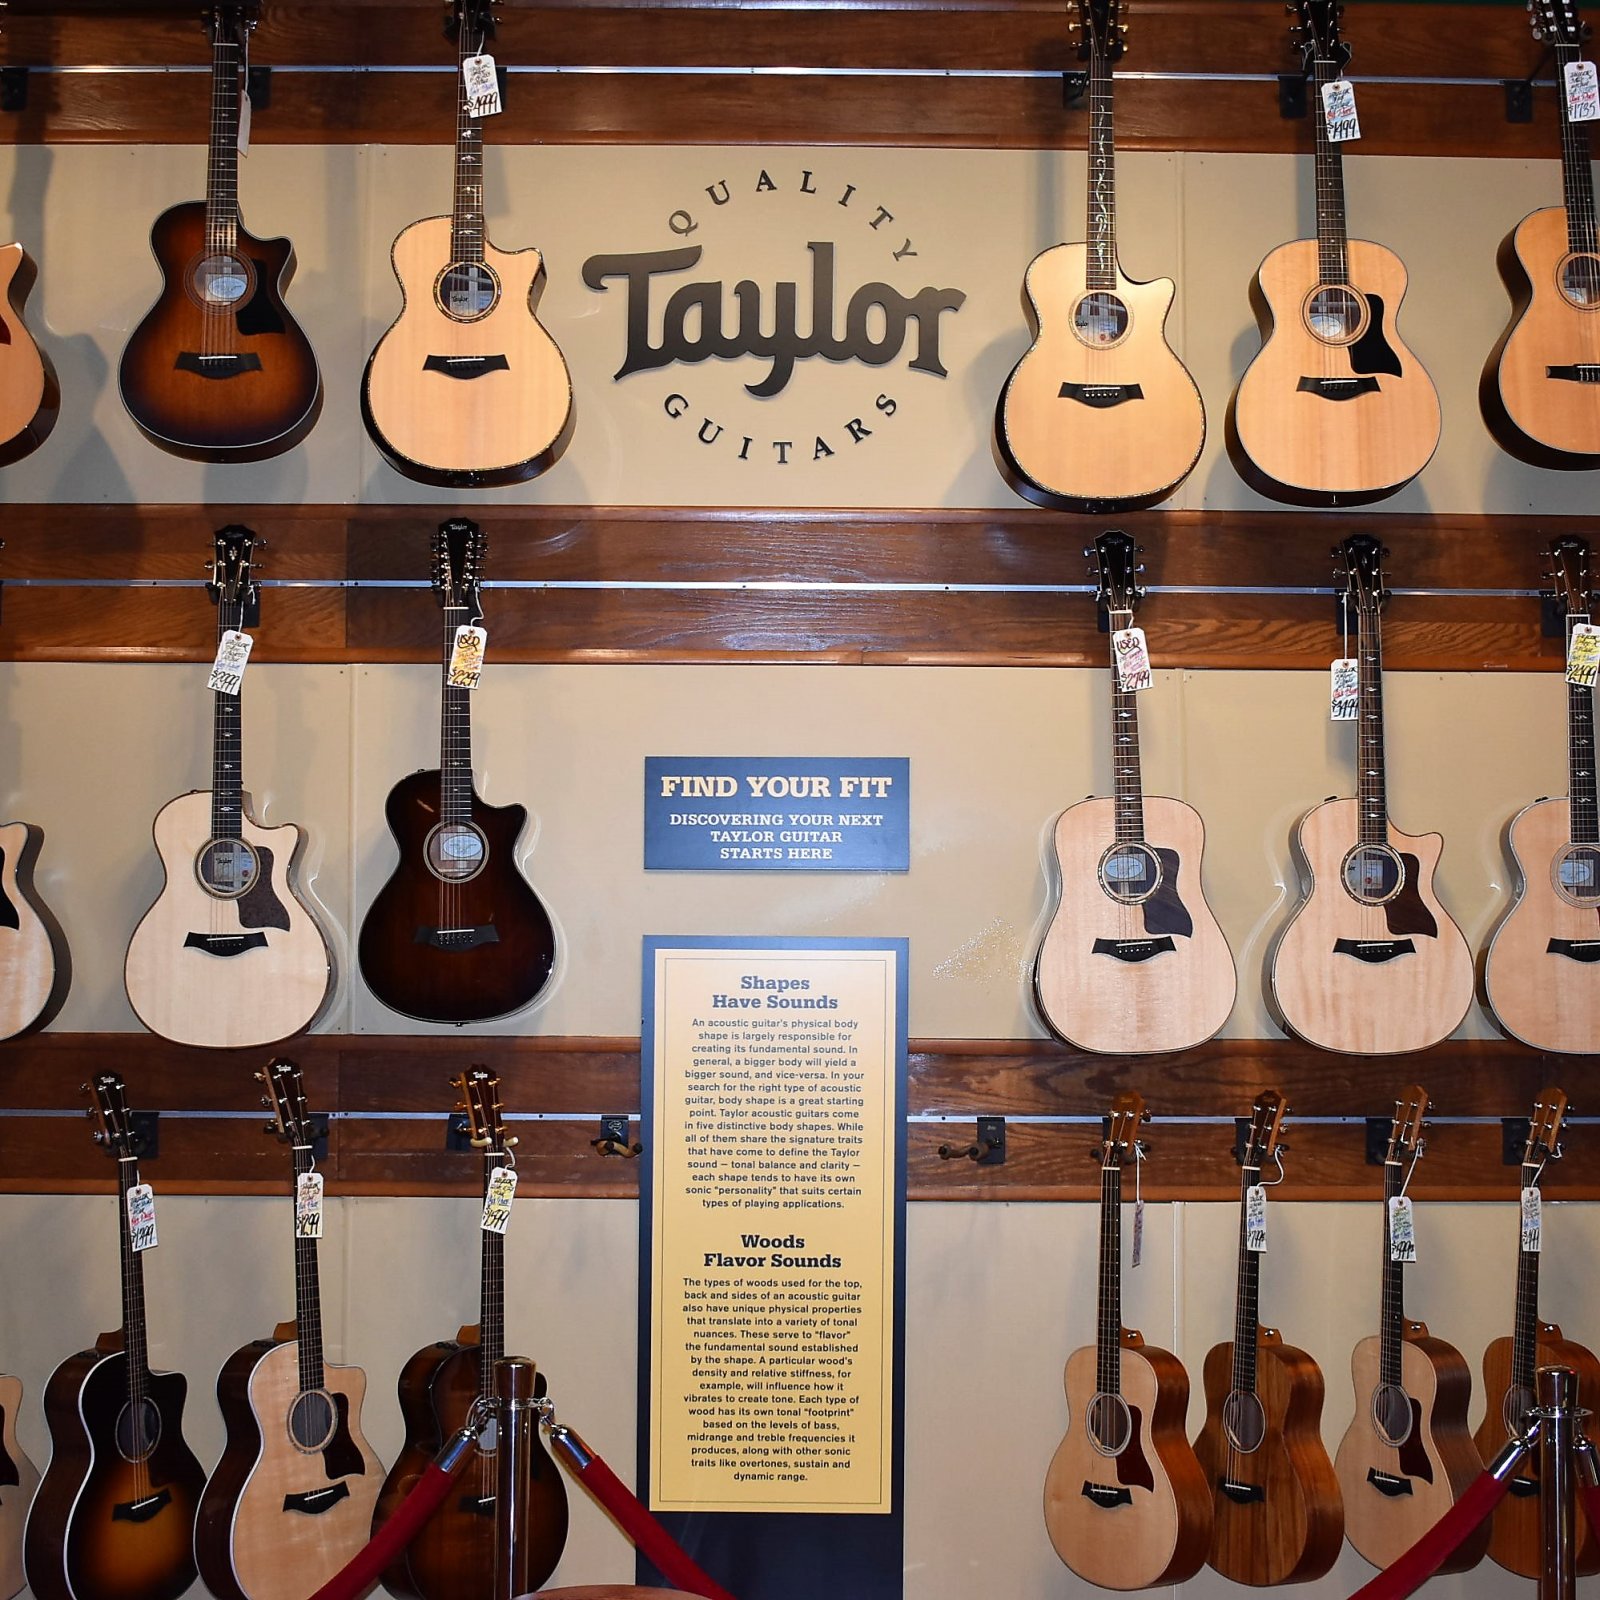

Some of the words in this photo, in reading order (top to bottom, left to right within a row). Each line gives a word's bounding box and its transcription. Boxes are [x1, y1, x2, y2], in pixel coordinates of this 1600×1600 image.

[668, 169, 918, 262] QUALITY
[581, 241, 967, 398] Taylor
[664, 393, 897, 464] GUITARS
[661, 776, 738, 797] FIND
[746, 776, 831, 798] YOUR
[839, 777, 893, 798] FIT
[669, 813, 784, 826] DISCOVERING
[788, 814, 834, 826] YOUR
[838, 814, 883, 826] NEXT
[710, 831, 775, 842] TAYLOR
[780, 831, 843, 842] GUITAR
[720, 848, 783, 859] STARTS
[787, 848, 833, 860] HERE
[740, 975, 809, 992] Shapes
[712, 994, 761, 1008] Have
[766, 994, 838, 1008] Sounds
[691, 1018, 704, 1026] An
[707, 1018, 748, 1027] acoustic
[791, 1019, 831, 1029] physical
[834, 1019, 858, 1029] body
[698, 1031, 728, 1040] shape
[731, 1031, 739, 1039] is
[742, 1031, 775, 1041] largely
[778, 1032, 835, 1041] responsible
[838, 1032, 852, 1040] for
[691, 1044, 731, 1054] creating
[734, 1044, 746, 1052] its
[748, 1044, 810, 1053] fundamental
[813, 1045, 845, 1053] sound.
[848, 1045, 857, 1053] In
[684, 1069, 716, 1079] bigger
[719, 1070, 751, 1079] sound,
[754, 1070, 772, 1078] and
[775, 1070, 827, 1078] vice-versa.
[843, 1072, 864, 1080] your
[689, 1108, 716, 1118] point.
[719, 1108, 748, 1118] Taylor
[751, 1109, 792, 1117] acoustic
[795, 1109, 829, 1119] guitars
[684, 1121, 693, 1129] in
[696, 1121, 714, 1129] five
[716, 1121, 766, 1130] distinctive
[769, 1122, 793, 1132] body
[796, 1122, 834, 1132] shapes.
[837, 1122, 863, 1130] While
[685, 1185, 711, 1194] sonic
[779, 1186, 798, 1194] that
[801, 1186, 825, 1195] suits
[828, 1187, 861, 1195] certain
[702, 1199, 728, 1208] types
[731, 1198, 741, 1207] of
[744, 1199, 779, 1209] playing
[782, 1199, 844, 1208] applications.
[740, 1234, 804, 1248] Woods
[703, 1253, 766, 1266] Flavor
[770, 1253, 841, 1267] Sounds
[682, 1277, 700, 1286] The
[704, 1278, 730, 1288] types
[733, 1278, 743, 1286] of
[746, 1278, 778, 1286] woods
[781, 1279, 805, 1287] used
[808, 1278, 822, 1287] for
[824, 1279, 840, 1287] the
[682, 1303, 703, 1311] also
[706, 1303, 729, 1312] have
[732, 1304, 765, 1314] unique
[768, 1304, 808, 1314] physical
[812, 1305, 861, 1314] properties
[740, 1330, 769, 1338] These
[802, 1330, 812, 1338] to
[685, 1342, 701, 1350] the
[704, 1342, 765, 1351] fundamental
[768, 1343, 798, 1351] sound
[801, 1343, 858, 1352] established
[690, 1355, 702, 1365] by
[705, 1355, 720, 1363] the
[724, 1355, 756, 1365] shape.
[758, 1356, 766, 1364] A
[768, 1356, 815, 1366] particular
[692, 1368, 727, 1378] density
[730, 1368, 748, 1376] and
[751, 1368, 787, 1377] relative
[790, 1369, 834, 1378] stiffness,
[837, 1369, 851, 1377] for
[699, 1381, 743, 1390] example,
[746, 1381, 762, 1389] will
[766, 1381, 810, 1390] influence
[813, 1382, 834, 1390] how
[837, 1382, 843, 1390] it
[688, 1406, 714, 1415] wood
[718, 1407, 735, 1415] has
[738, 1407, 750, 1415] its
[776, 1407, 801, 1416] tonal
[702, 1419, 732, 1428] based
[750, 1420, 766, 1428] the
[769, 1420, 798, 1429] levels
[801, 1420, 810, 1429] of
[814, 1421, 839, 1430] bass,
[687, 1432, 733, 1442] midrange
[736, 1433, 754, 1441] and
[757, 1433, 785, 1441] treble
[788, 1433, 845, 1443] frequencies
[848, 1434, 855, 1442] it
[691, 1446, 739, 1455] produces,
[742, 1446, 769, 1456] along
[772, 1446, 792, 1454] with
[795, 1446, 821, 1455] other
[824, 1447, 850, 1455] sonic
[691, 1458, 716, 1466] traits
[719, 1458, 736, 1467] like
[739, 1459, 790, 1468] overtones,
[793, 1459, 829, 1468] sustain
[832, 1460, 850, 1468] and
[733, 1471, 774, 1481] dynamic
[777, 1474, 807, 1483] range.
